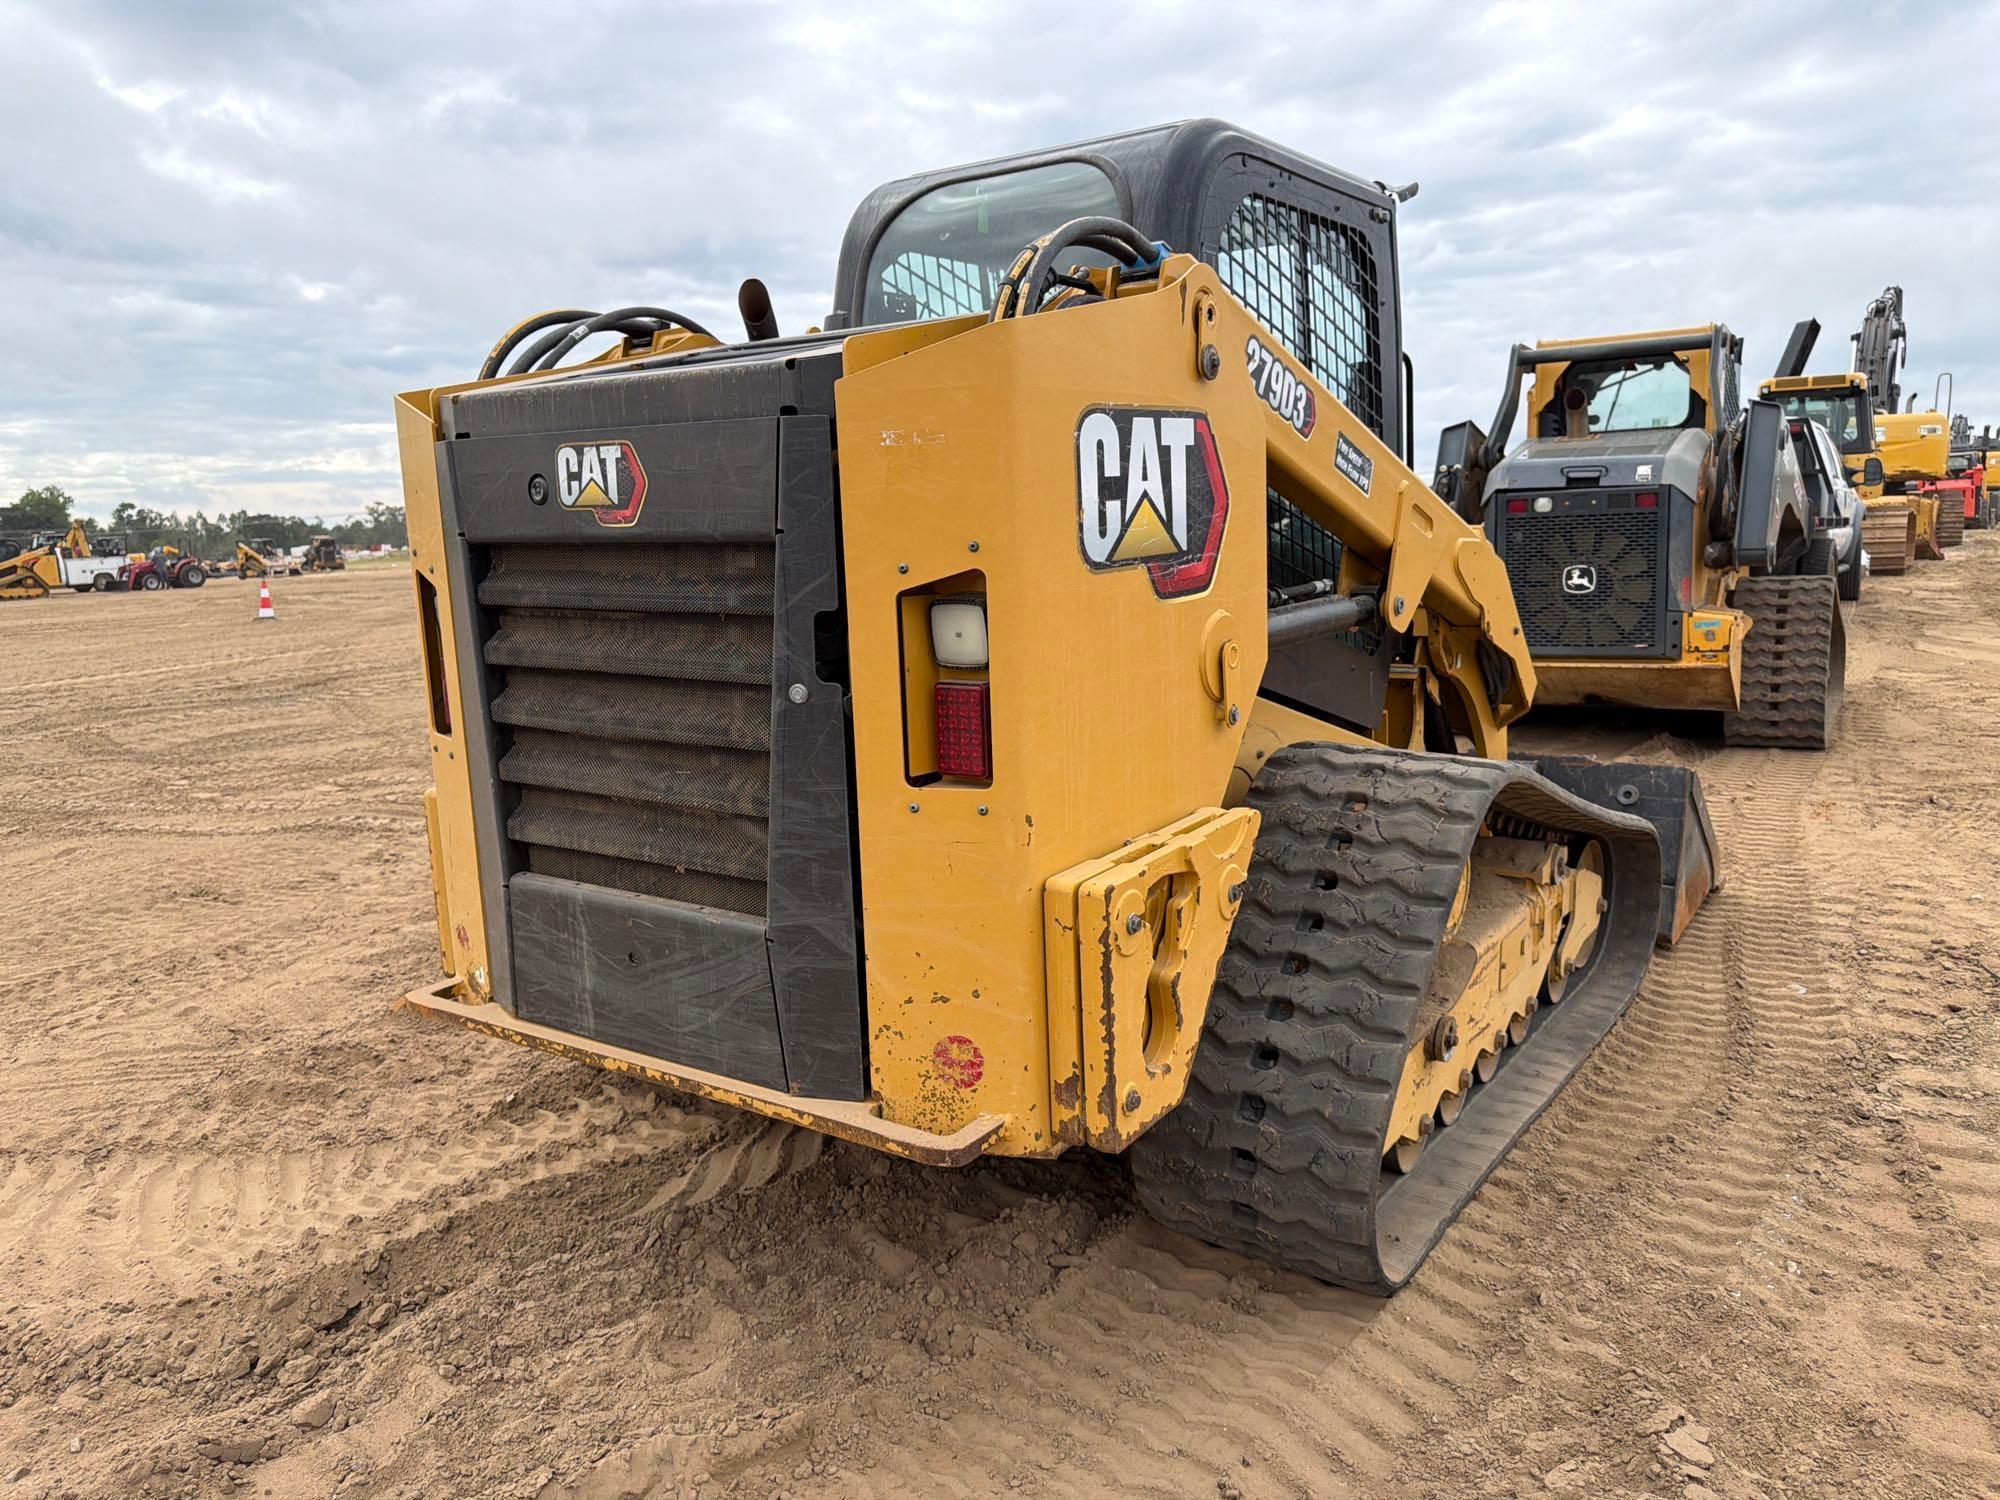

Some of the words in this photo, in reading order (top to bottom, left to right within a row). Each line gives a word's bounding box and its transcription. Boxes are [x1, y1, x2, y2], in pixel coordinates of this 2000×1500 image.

[1246, 338, 1307, 429] 279D3
[557, 445, 622, 506] CAT
[1079, 412, 1195, 563] CAT
